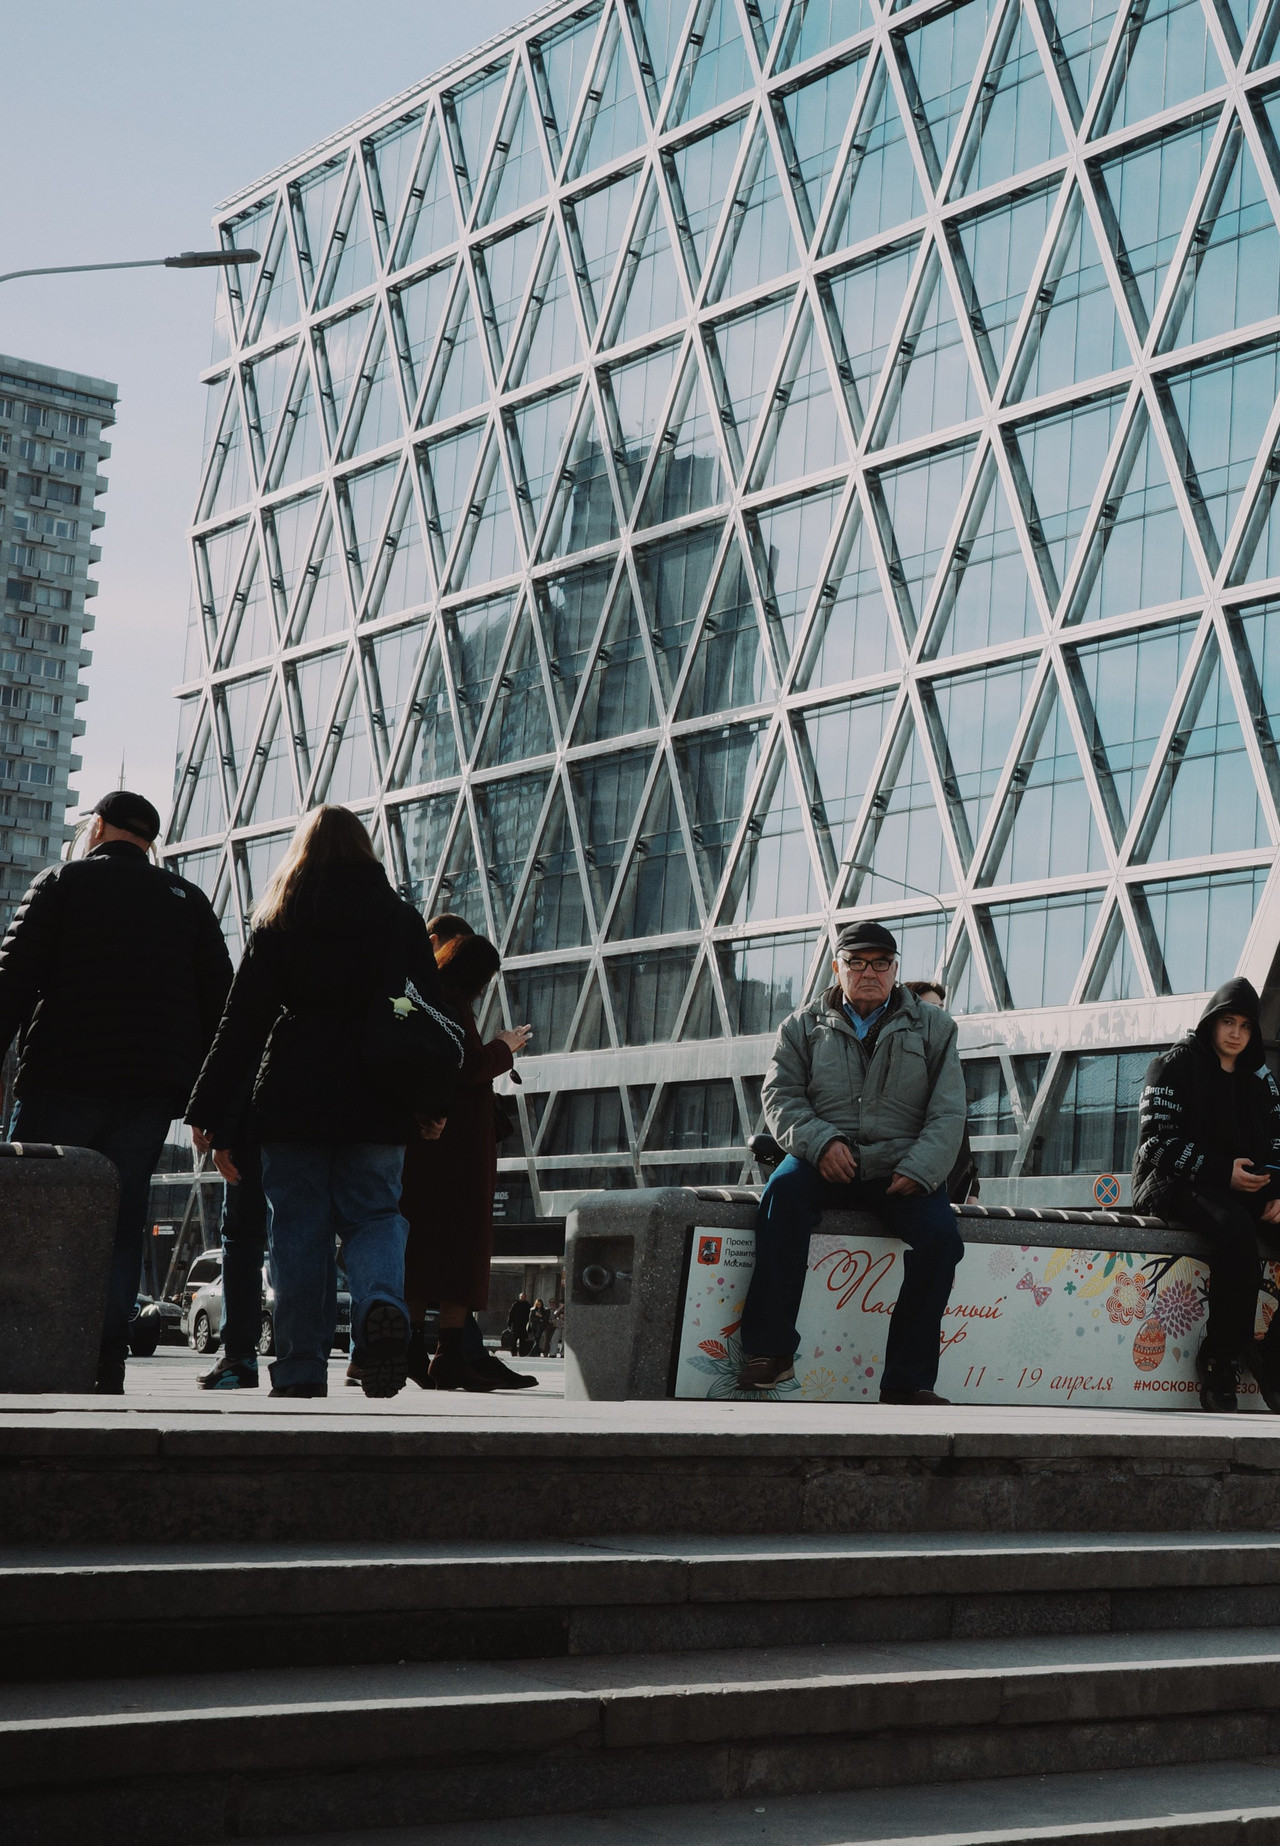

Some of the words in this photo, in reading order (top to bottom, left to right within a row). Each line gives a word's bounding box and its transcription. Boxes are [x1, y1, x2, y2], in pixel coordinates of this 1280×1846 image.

[1144, 1085, 1175, 1097] Angels
[726, 1237, 754, 1247] Проект
[725, 1248, 756, 1258] Правите
[723, 1259, 753, 1268] Москвы
[939, 1322, 968, 1357] ар
[963, 1366, 986, 1388] 11
[1016, 1367, 1043, 1389] 19
[1050, 1374, 1114, 1400] апреля
